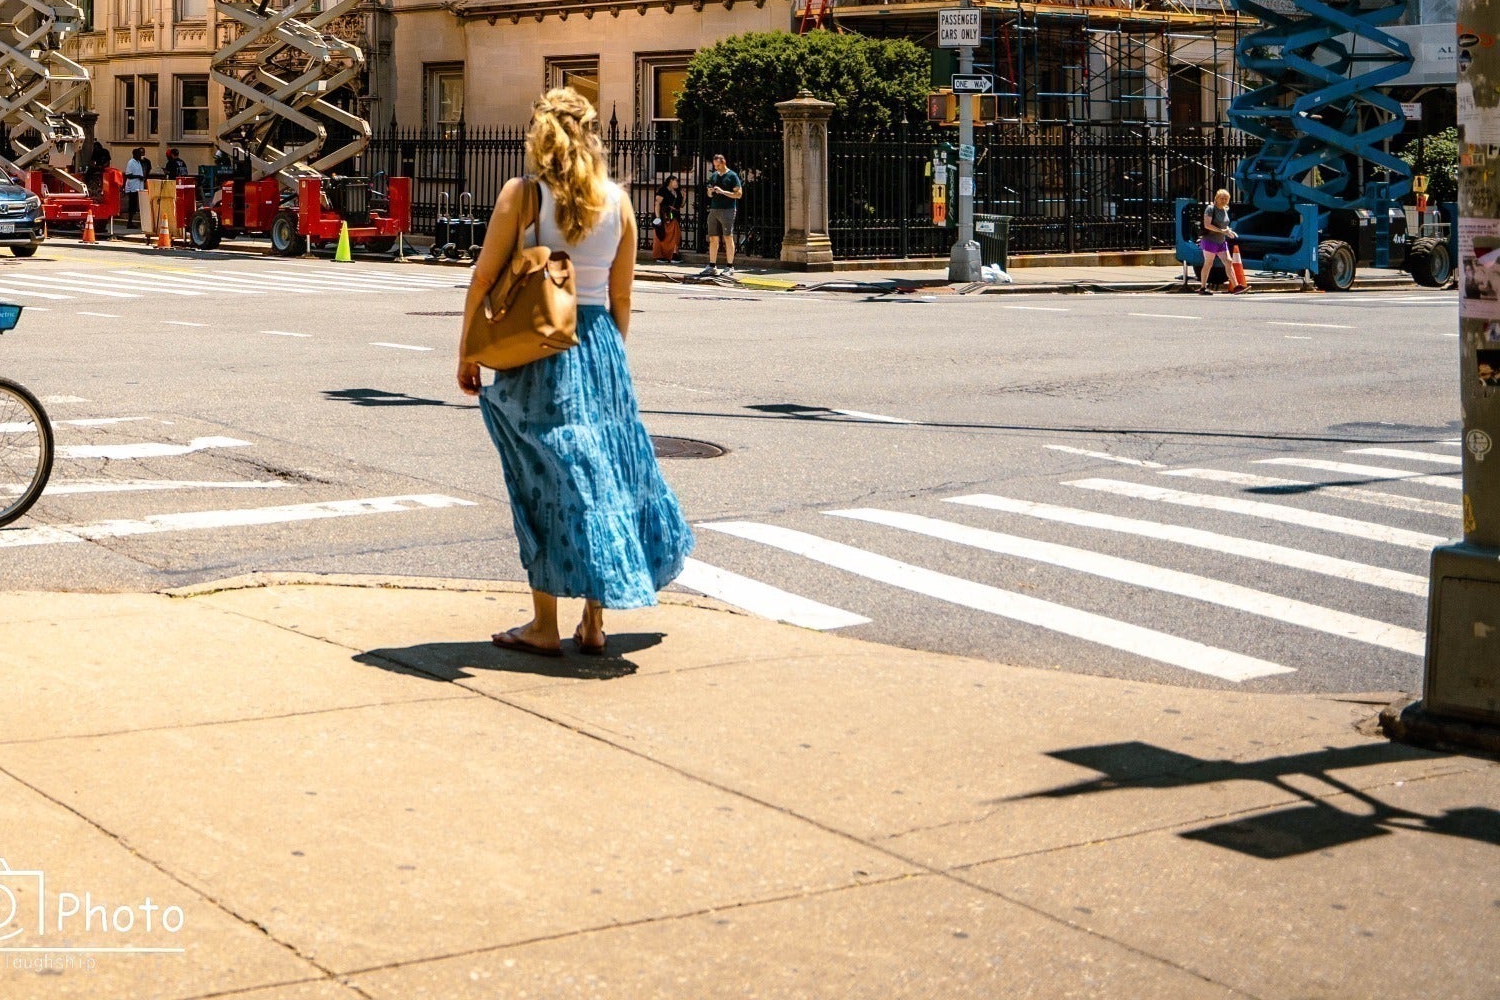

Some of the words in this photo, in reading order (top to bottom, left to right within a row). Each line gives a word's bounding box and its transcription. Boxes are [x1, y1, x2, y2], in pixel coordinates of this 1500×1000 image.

[941, 14, 978, 26] PASSENGER
[941, 29, 958, 40] CARS
[960, 28, 978, 40] ONLY
[955, 80, 968, 88] ONE
[974, 80, 988, 88] WAY
[1392, 233, 1406, 244] 4x4
